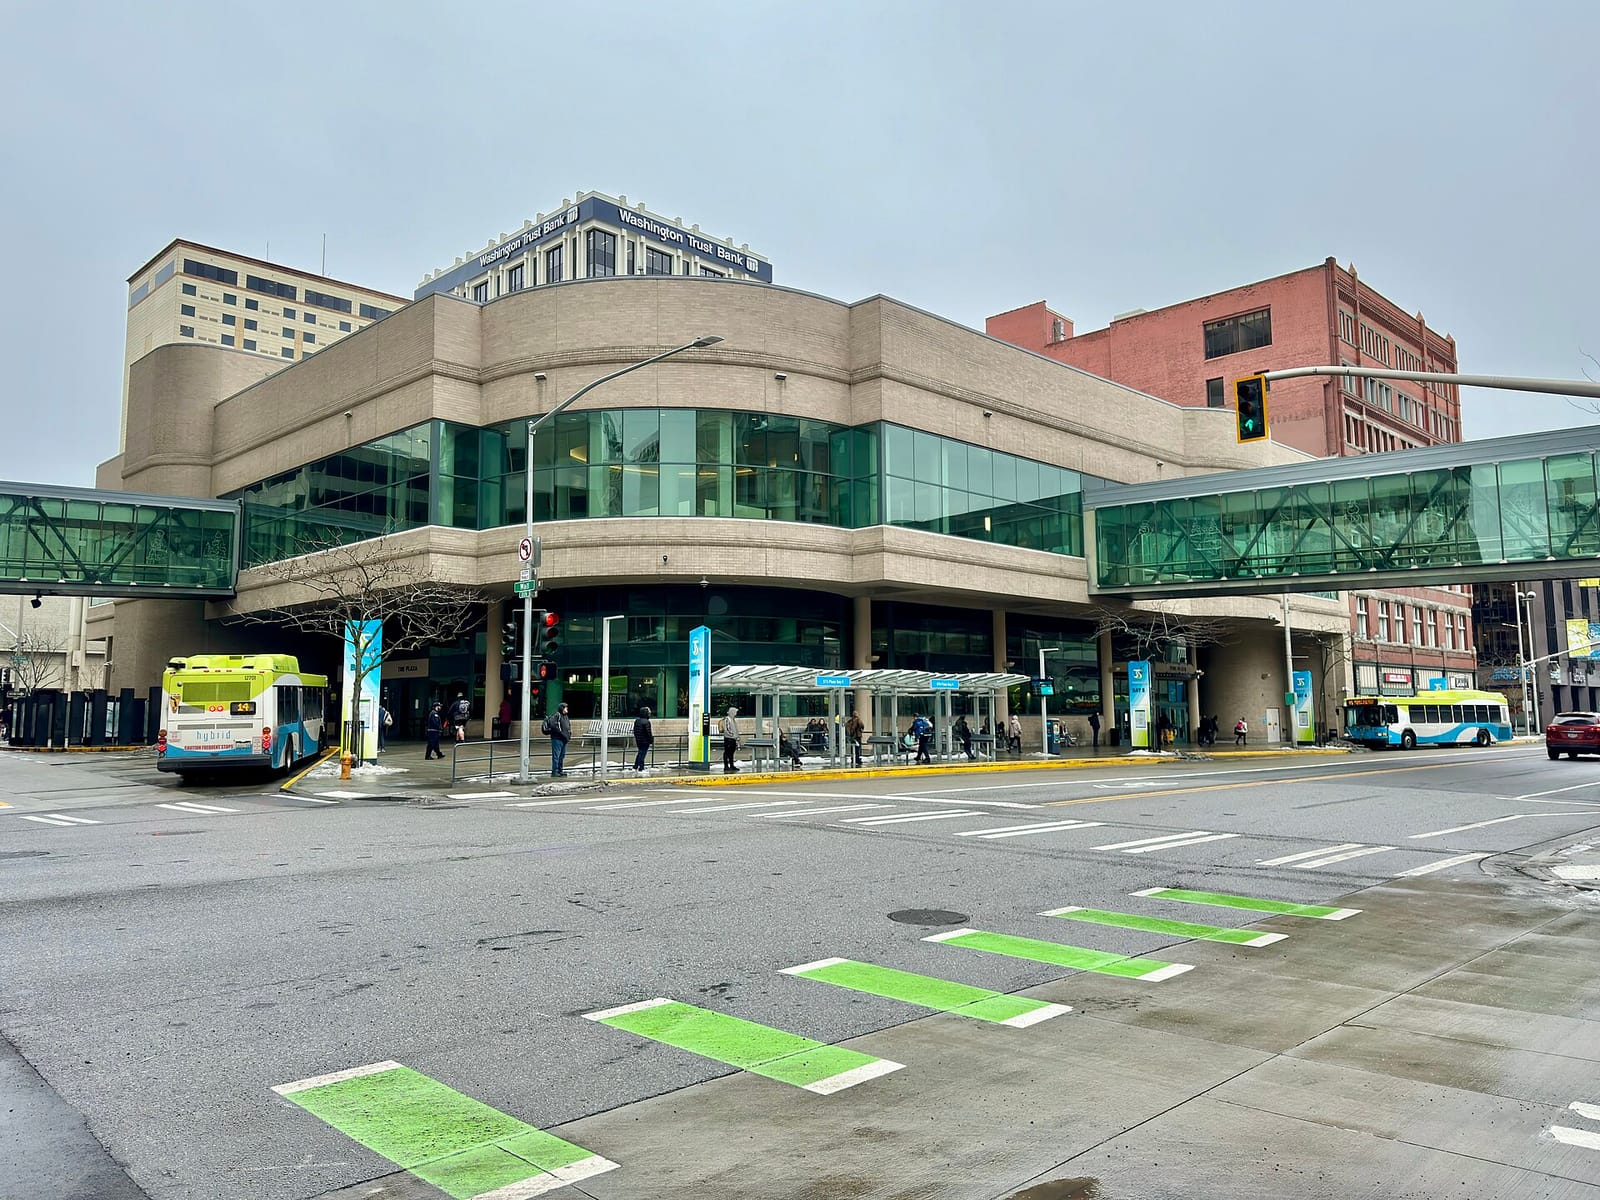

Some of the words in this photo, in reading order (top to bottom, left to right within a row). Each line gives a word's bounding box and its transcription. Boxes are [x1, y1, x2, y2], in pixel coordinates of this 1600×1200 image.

[480, 239, 521, 267] Washington
[521, 226, 542, 245] Trust
[543, 214, 565, 234] Bank
[619, 208, 684, 243] Washington
[686, 235, 713, 254] Trust
[717, 246, 744, 266] Bank
[196, 730, 231, 742] hybrid
